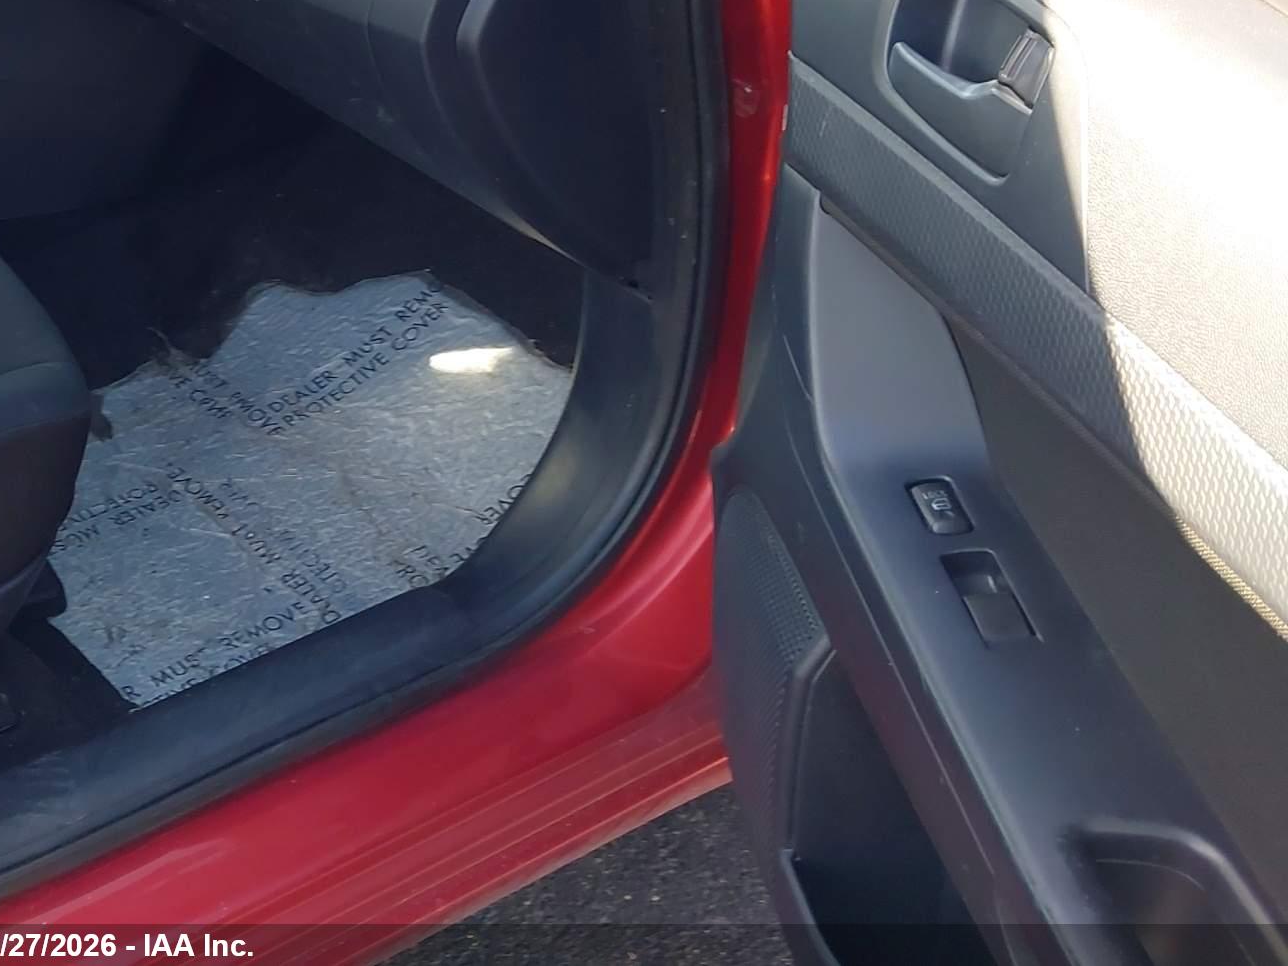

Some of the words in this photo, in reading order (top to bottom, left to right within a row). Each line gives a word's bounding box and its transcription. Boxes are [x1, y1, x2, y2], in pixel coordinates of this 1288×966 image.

[268, 369, 340, 413] DEALER
[342, 325, 394, 367] MUST
[284, 351, 390, 427] PROTECTIVE
[392, 301, 449, 352] COVER
[217, 600, 311, 650] REMOVE
